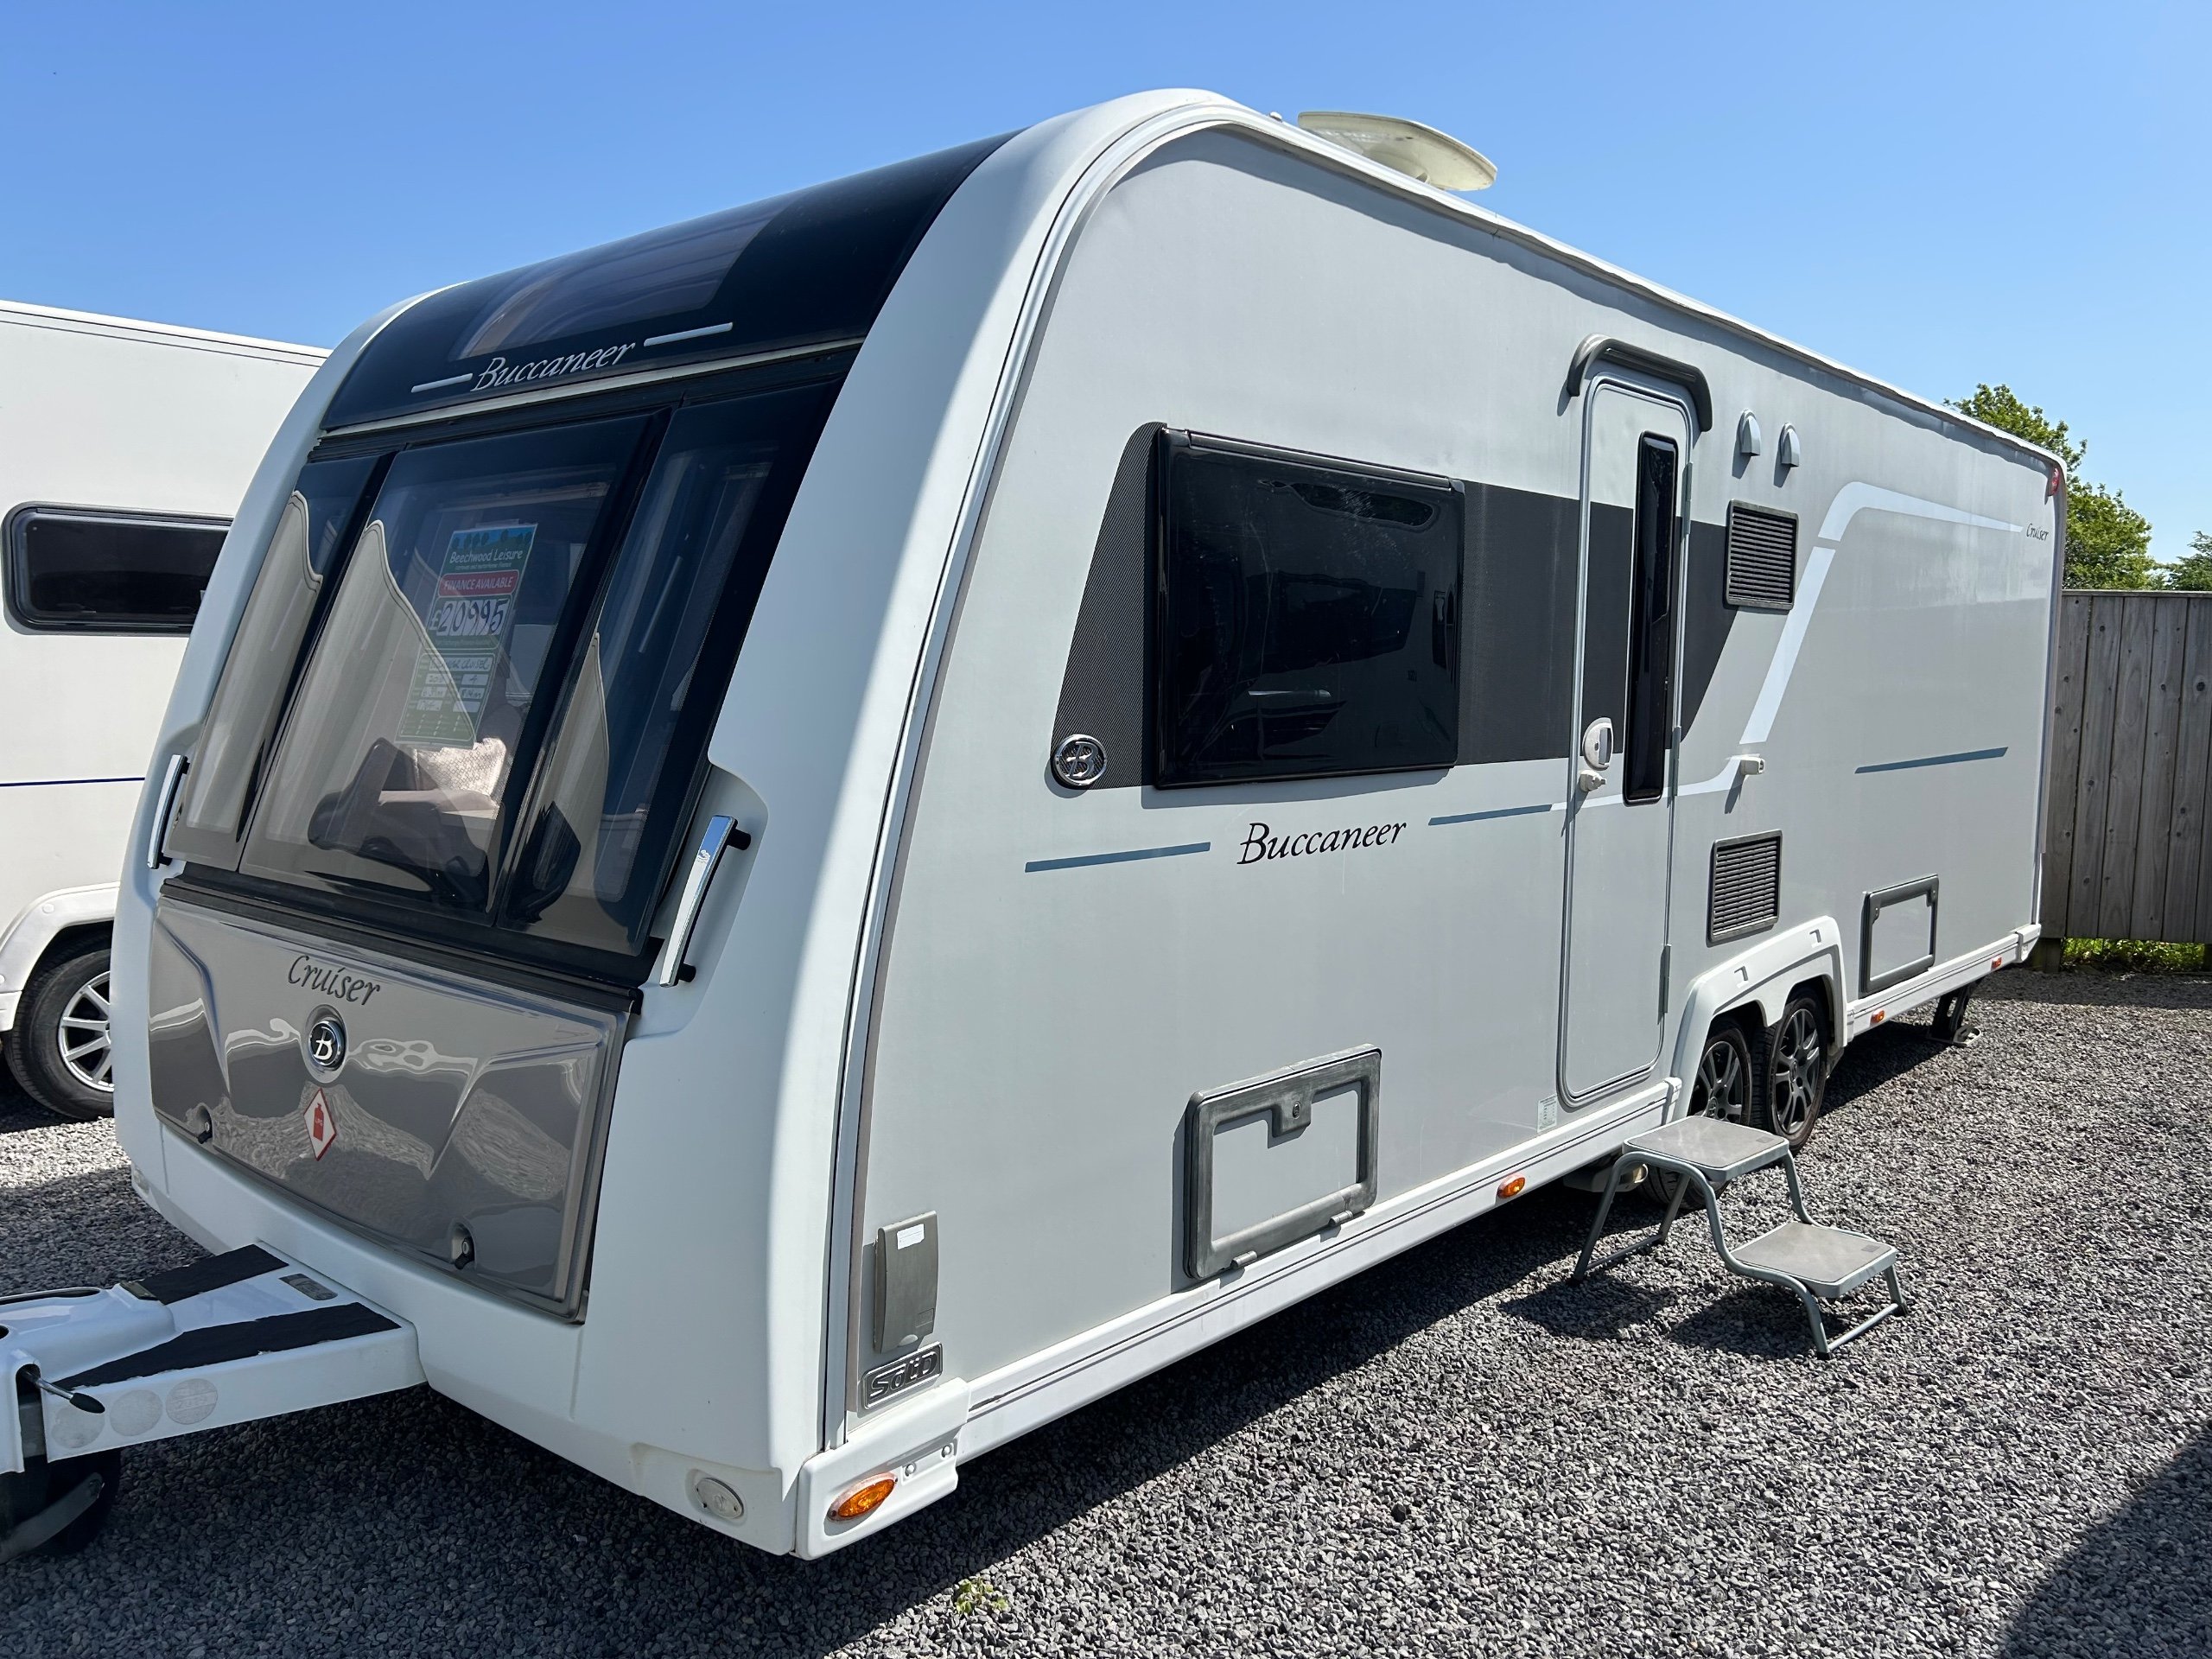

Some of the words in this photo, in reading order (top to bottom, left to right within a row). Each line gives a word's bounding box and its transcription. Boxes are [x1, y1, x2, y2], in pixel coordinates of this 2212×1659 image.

[470, 342, 636, 391] Buccaneer
[2026, 523, 2049, 541] Cruiser
[449, 549, 494, 564] Beechwood
[493, 548, 523, 561] Leisure
[443, 579, 476, 591] FINANCE
[474, 576, 513, 589] AVAILABLE
[1236, 822, 1407, 865] Buccaneer
[288, 955, 380, 1006] Cruiser
